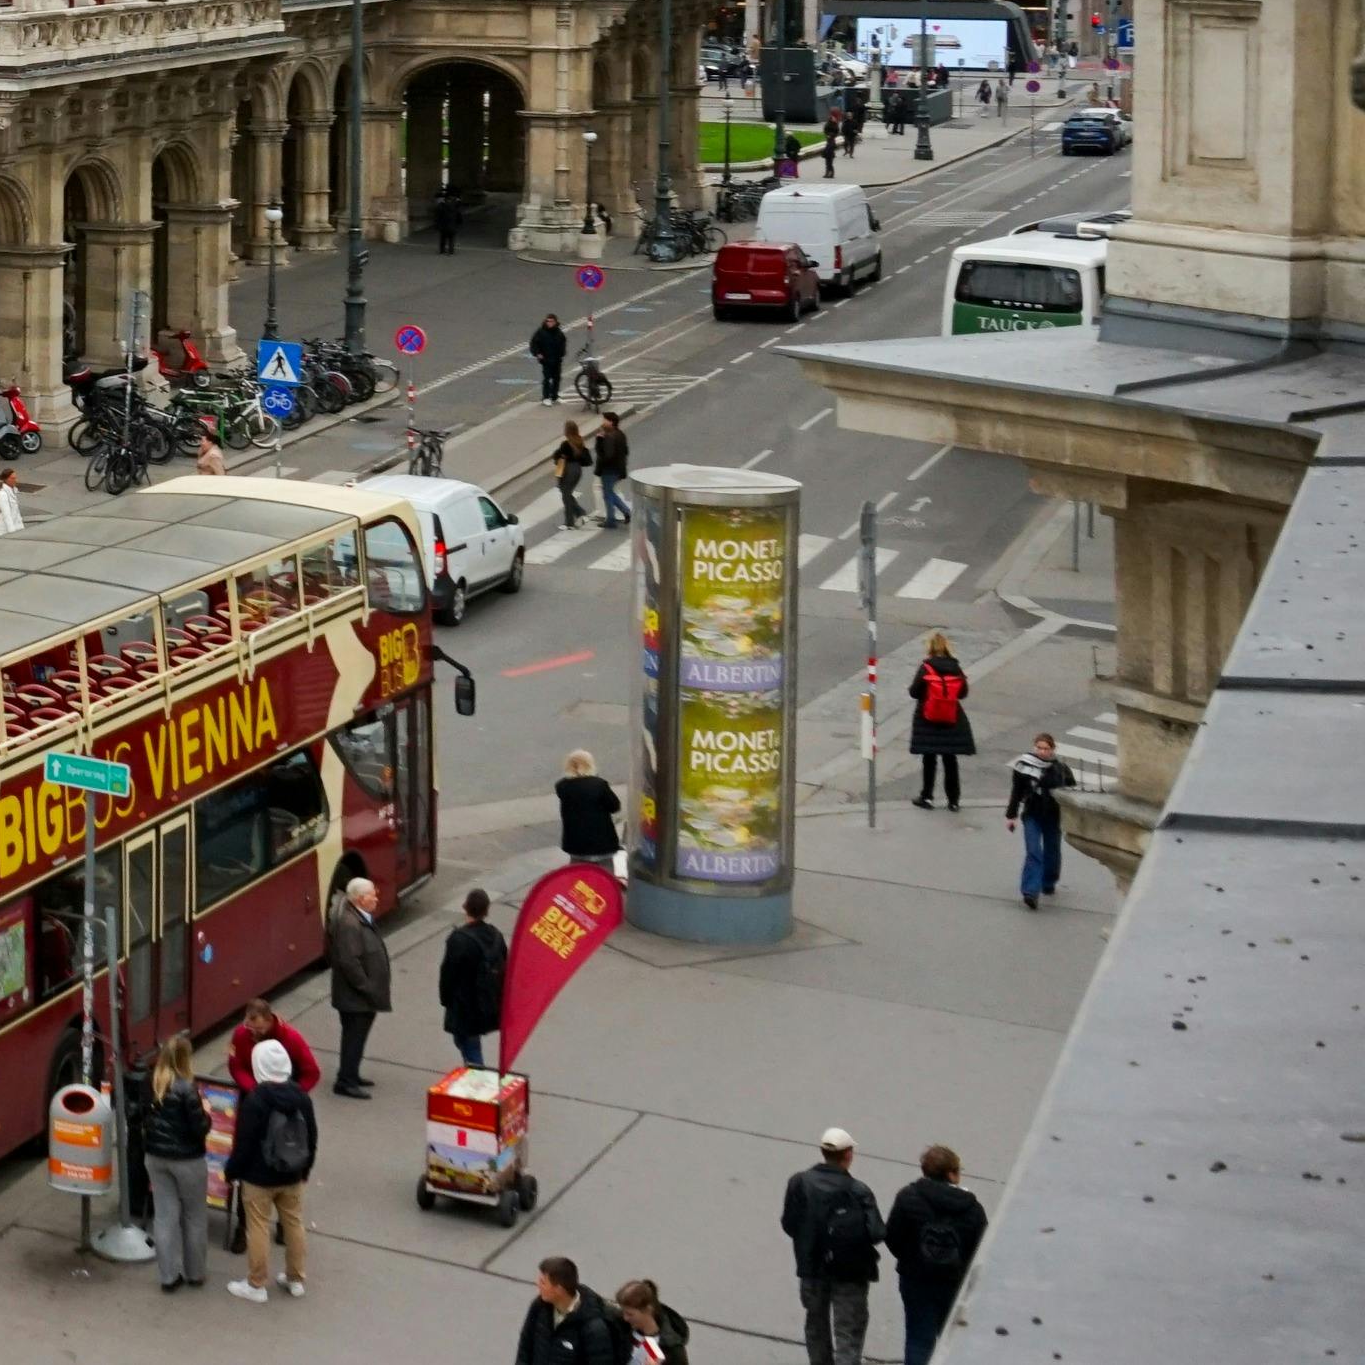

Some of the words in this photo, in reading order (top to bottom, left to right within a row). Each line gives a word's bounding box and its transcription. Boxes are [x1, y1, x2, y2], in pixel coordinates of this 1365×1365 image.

[977, 316, 1038, 332] TAUCK
[694, 539, 778, 560] MONET
[693, 560, 783, 582] PICASSO
[380, 629, 402, 667] BIG
[144, 676, 278, 801] VIENNA
[691, 729, 776, 751] MONET
[690, 750, 780, 773] PICASSO
[544, 906, 587, 941] BUY
[529, 922, 568, 960] HERE
